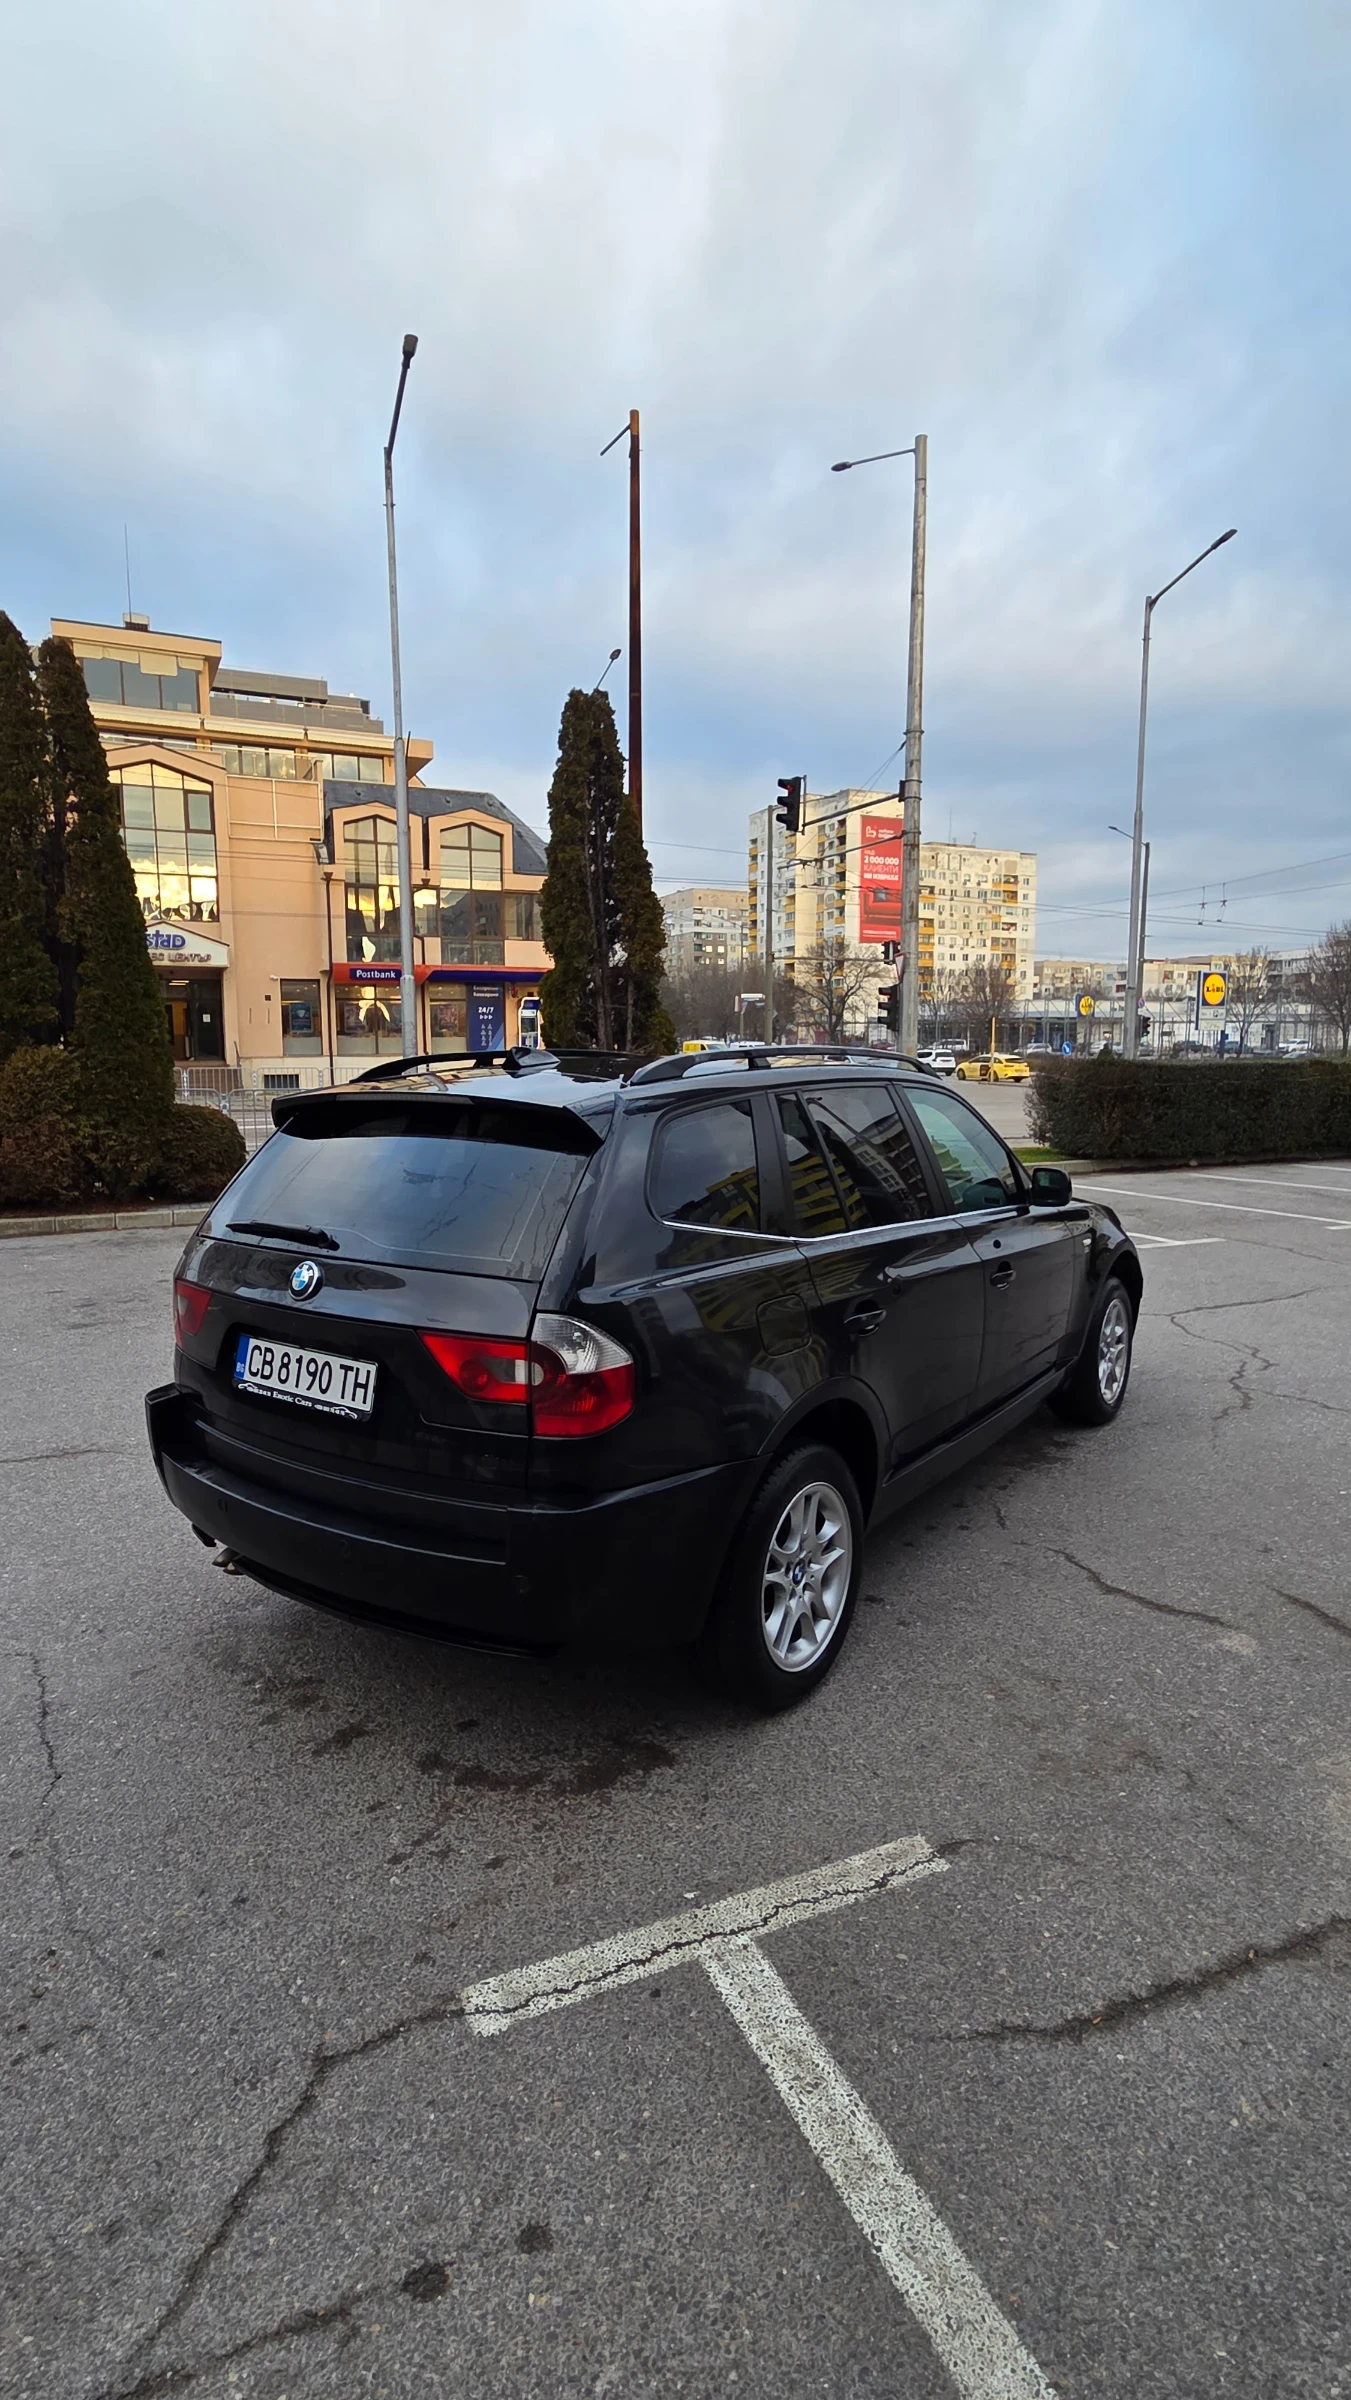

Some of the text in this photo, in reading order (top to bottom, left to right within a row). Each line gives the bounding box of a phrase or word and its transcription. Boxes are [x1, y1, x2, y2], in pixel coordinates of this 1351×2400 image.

[869, 855, 884, 864] 000
[885, 856, 900, 865] 000
[356, 969, 396, 979] Postbank
[478, 1006, 494, 1014] 24/7
[273, 1391, 312, 1407] Exotic Cars
